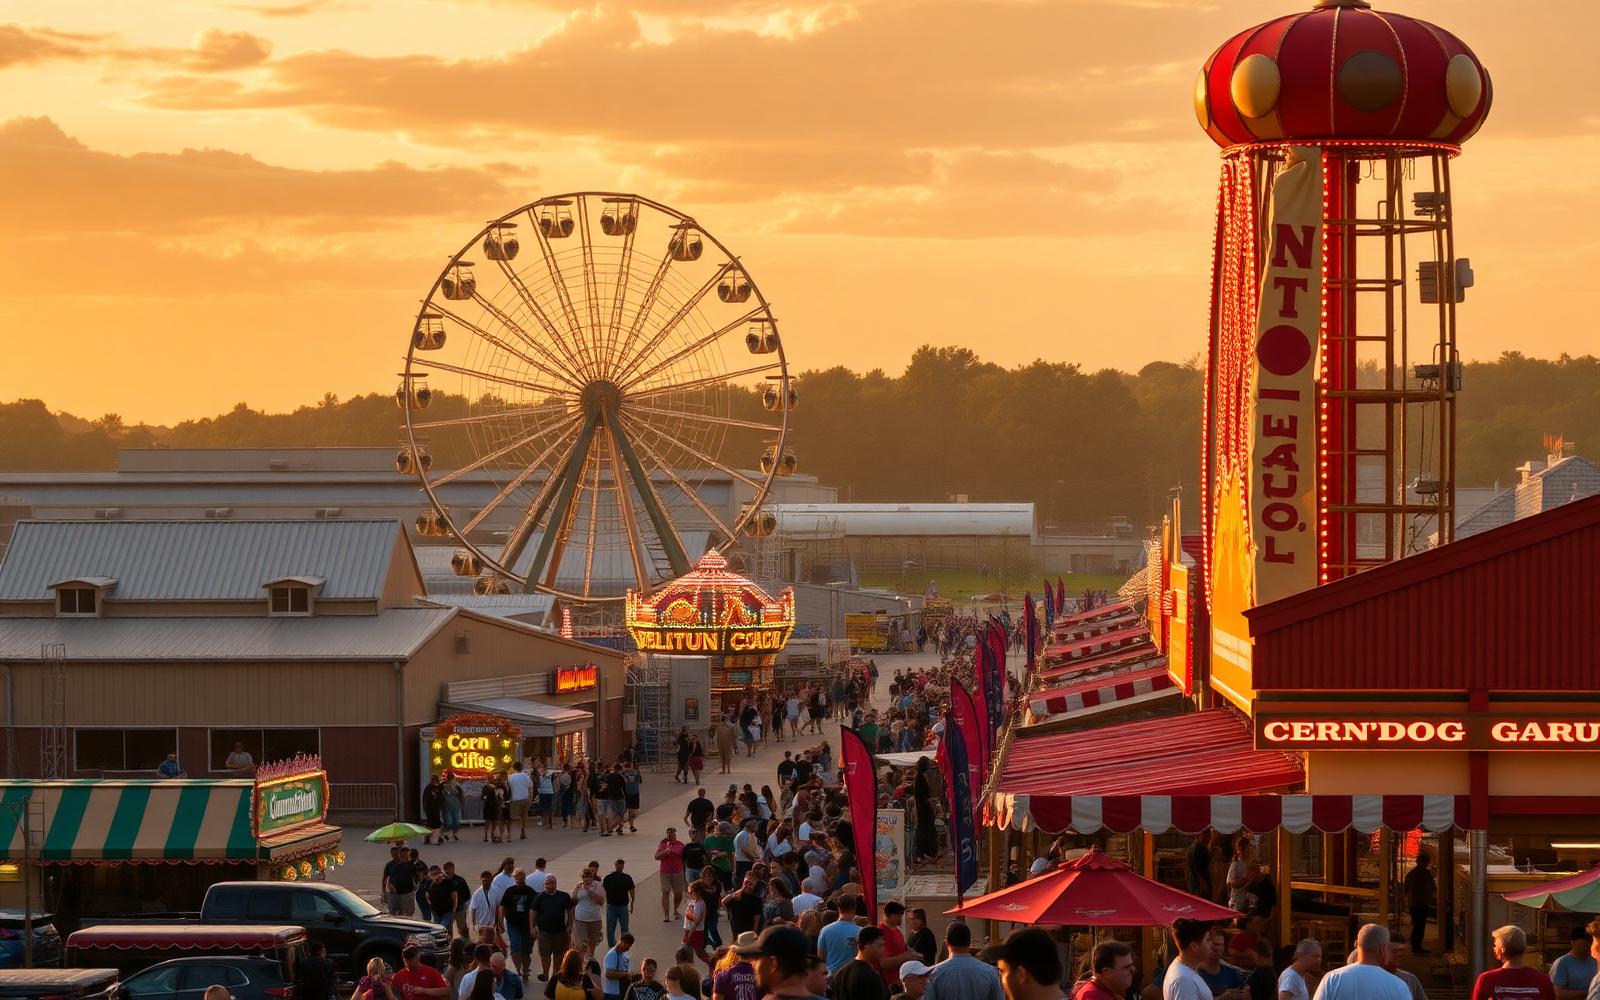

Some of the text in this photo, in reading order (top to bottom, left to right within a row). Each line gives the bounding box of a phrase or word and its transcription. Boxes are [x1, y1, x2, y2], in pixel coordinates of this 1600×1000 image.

[447, 733, 489, 751] Corn
[1263, 721, 1600, 743] CERN'DOG GARU
